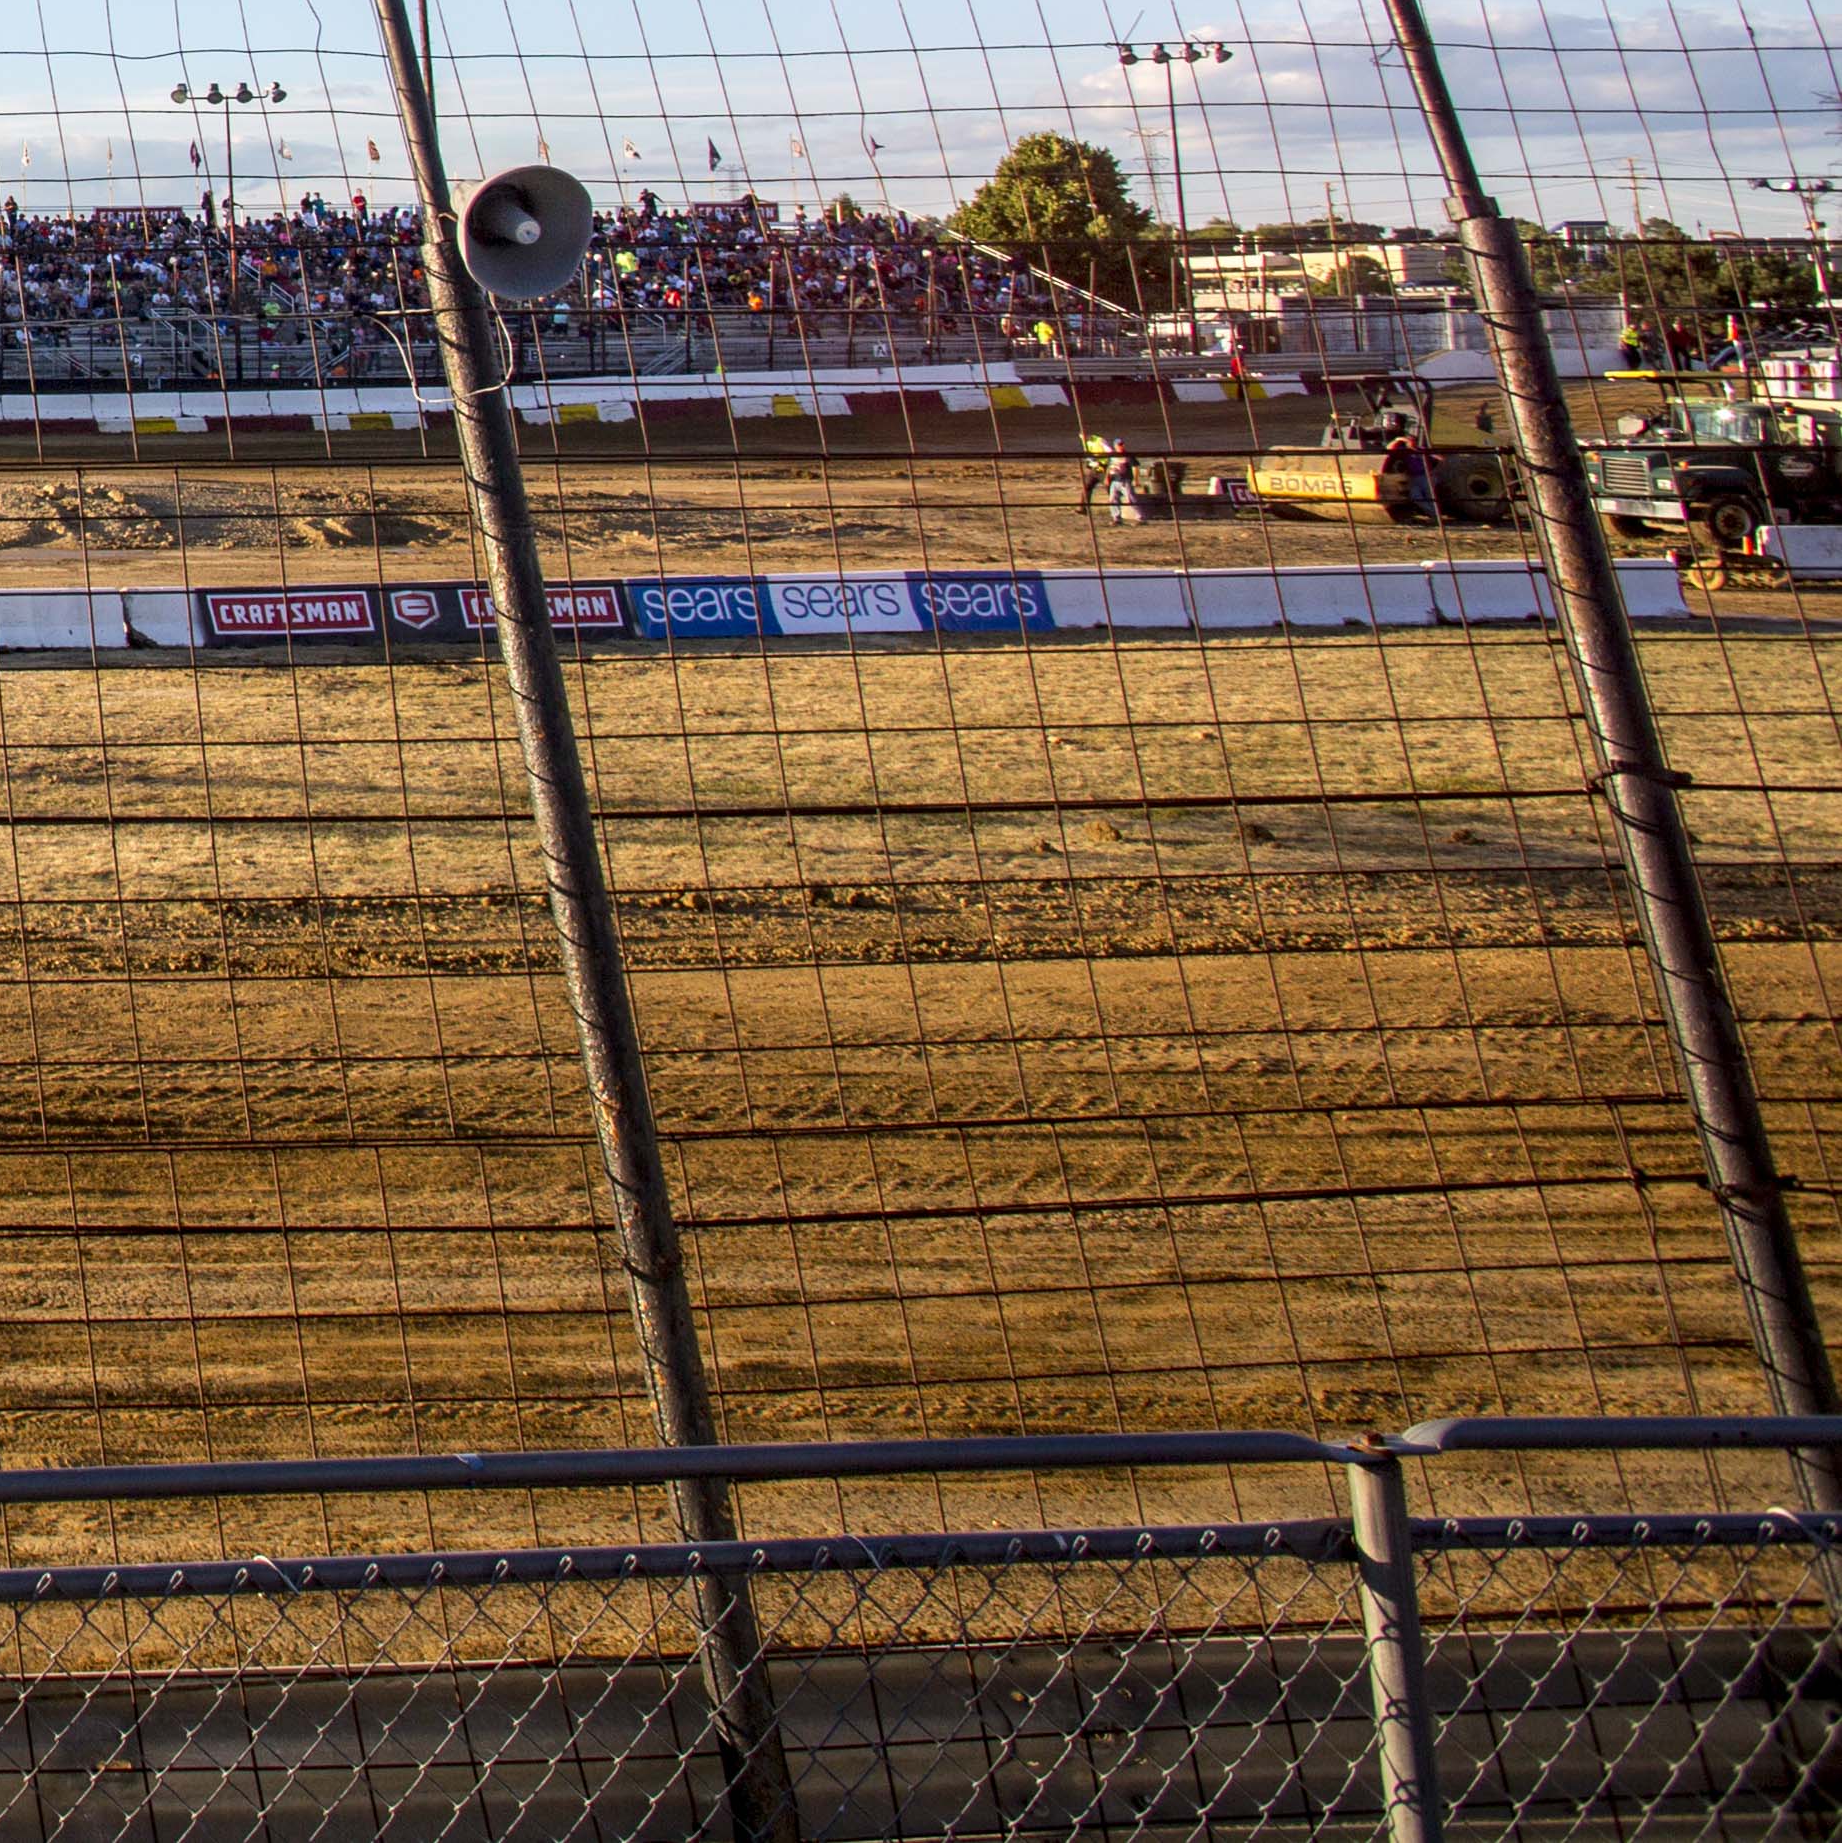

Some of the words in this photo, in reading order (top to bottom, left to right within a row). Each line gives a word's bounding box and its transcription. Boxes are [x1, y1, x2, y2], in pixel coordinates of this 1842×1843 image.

[1270, 477, 1353, 495] BOMAG
[220, 600, 361, 625] CRAFTSMAN
[643, 585, 760, 623] sears
[782, 583, 901, 618] sears
[923, 582, 1038, 617] sears
